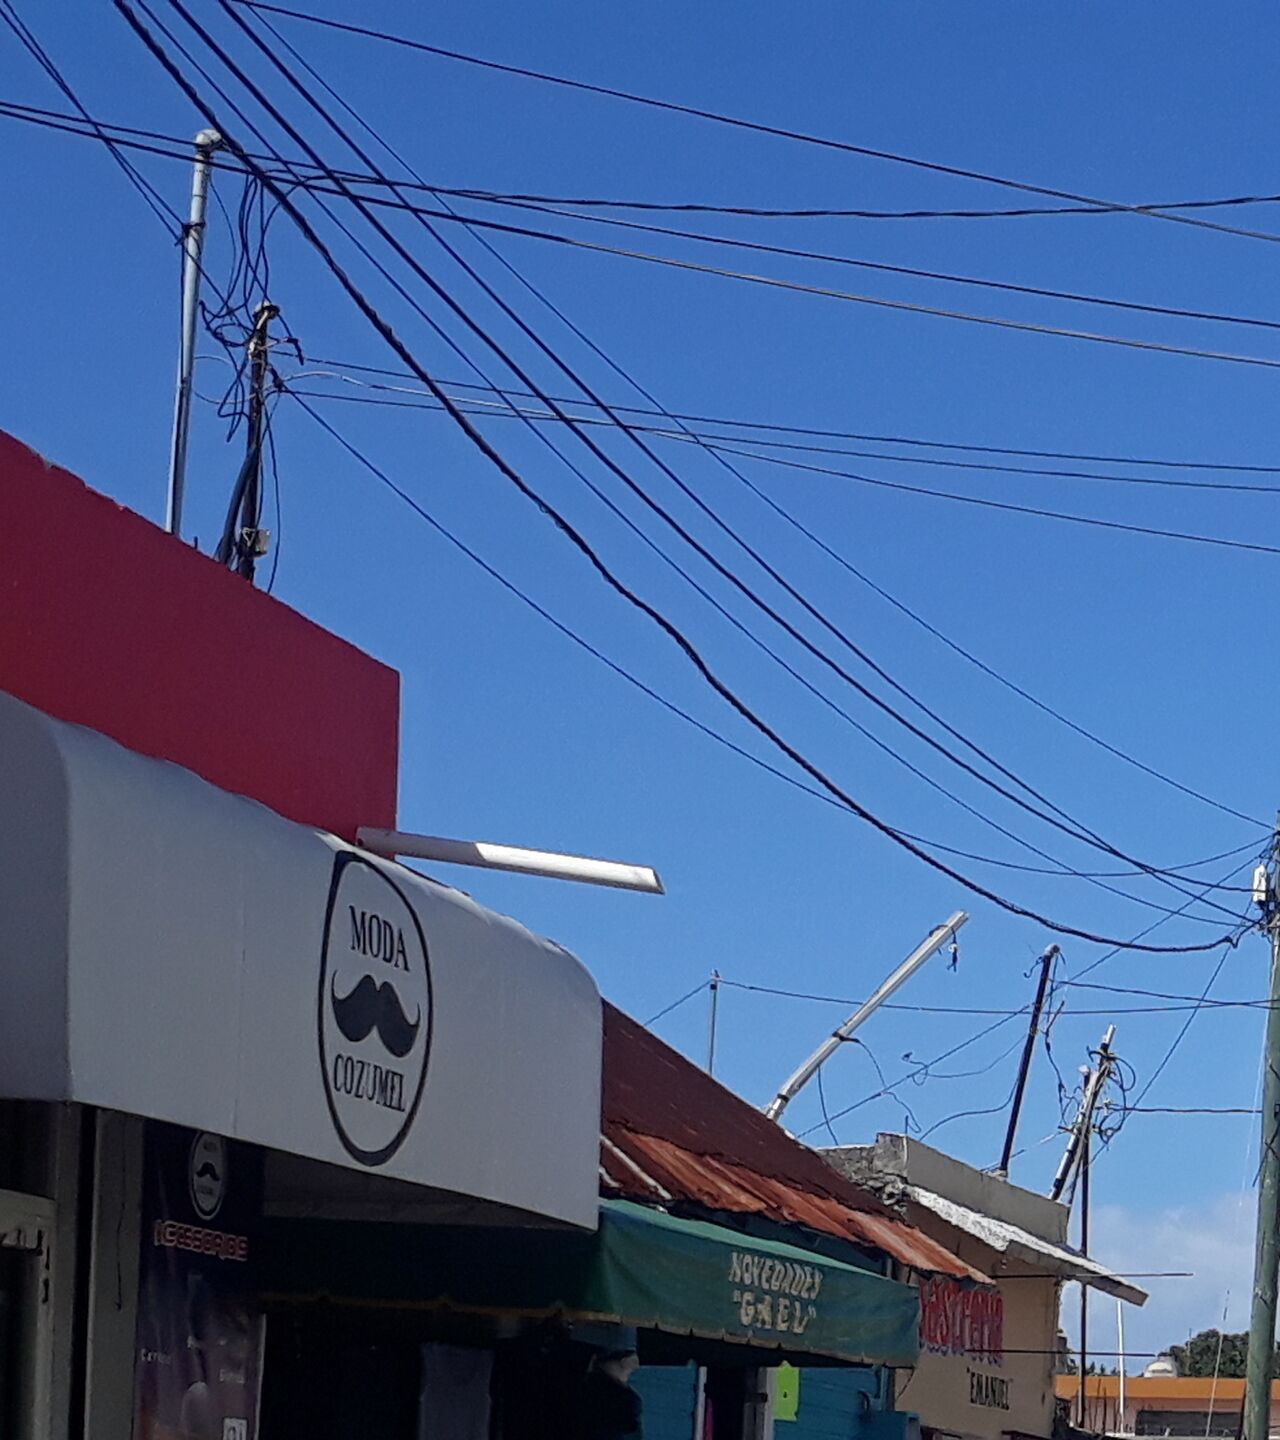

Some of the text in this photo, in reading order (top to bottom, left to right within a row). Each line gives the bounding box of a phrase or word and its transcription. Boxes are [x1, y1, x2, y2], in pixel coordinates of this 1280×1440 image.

[349, 905, 410, 971] MODA
[333, 1053, 406, 1112] COZUMEL
[728, 1252, 823, 1299] NOVEDADES
